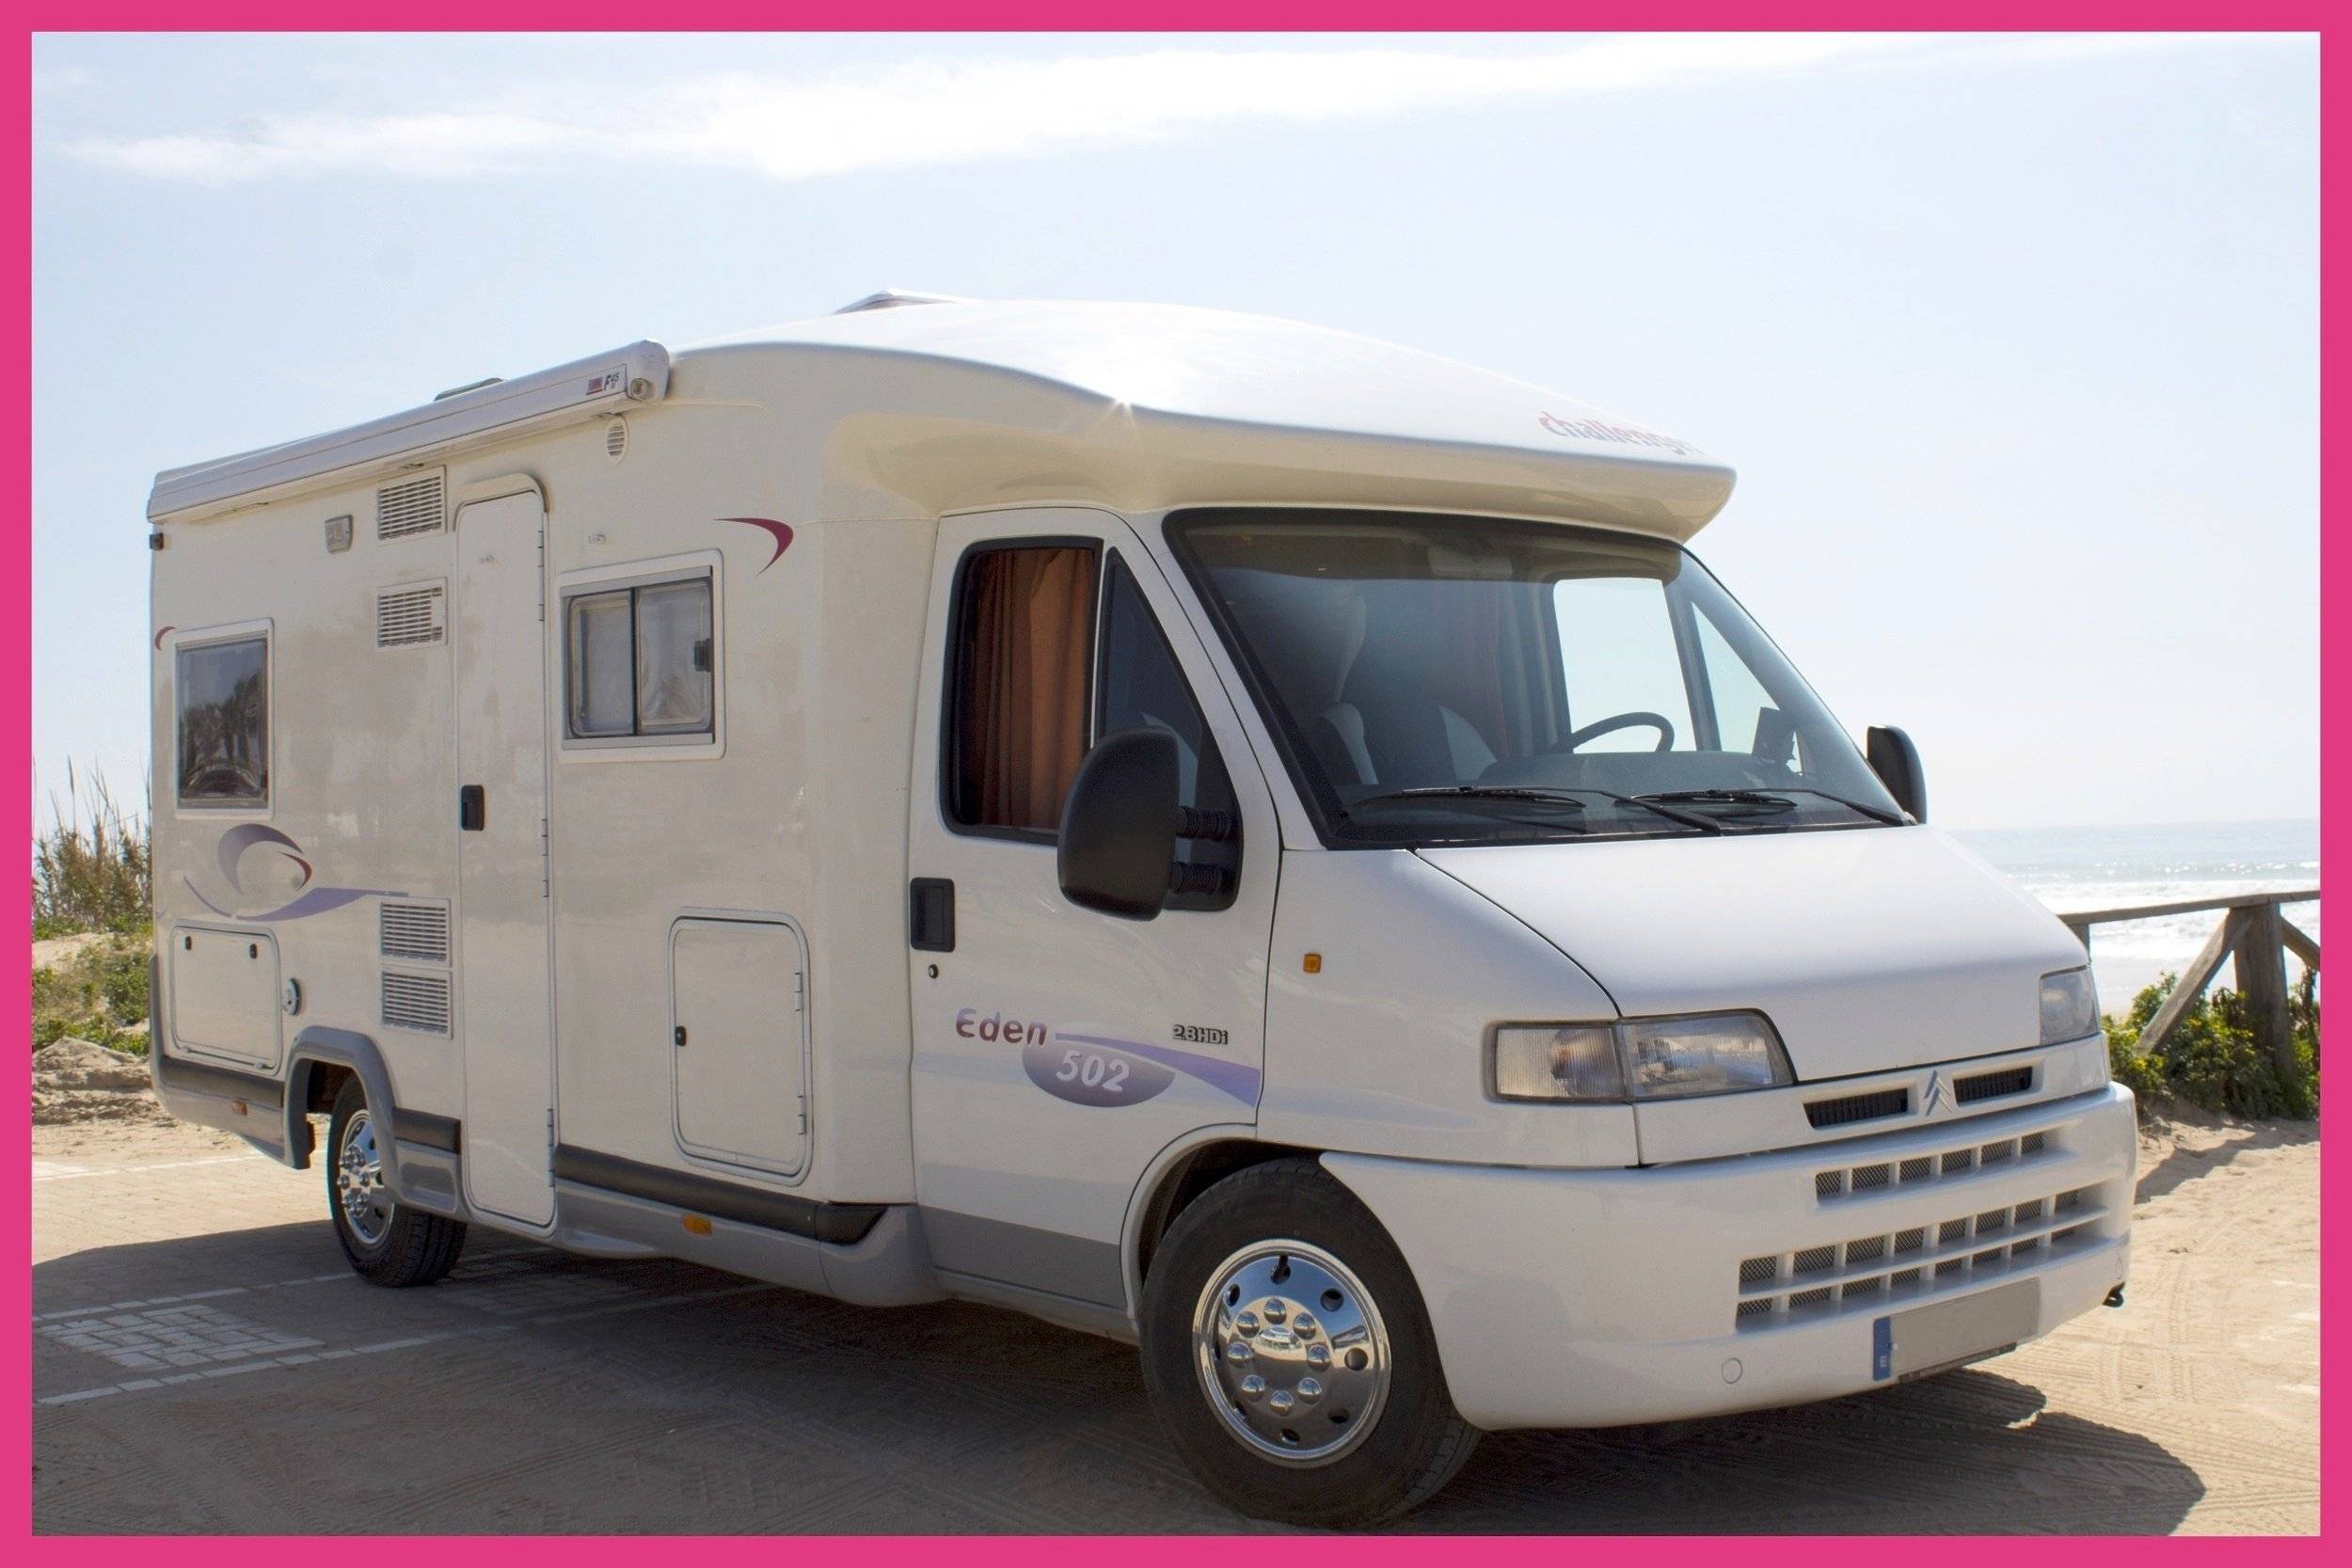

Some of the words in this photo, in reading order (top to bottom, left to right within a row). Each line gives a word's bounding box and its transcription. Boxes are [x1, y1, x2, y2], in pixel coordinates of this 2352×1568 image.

[1538, 410, 1705, 455] challeng
[955, 1006, 1048, 1046] Eden
[1056, 1050, 1130, 1092] 502
